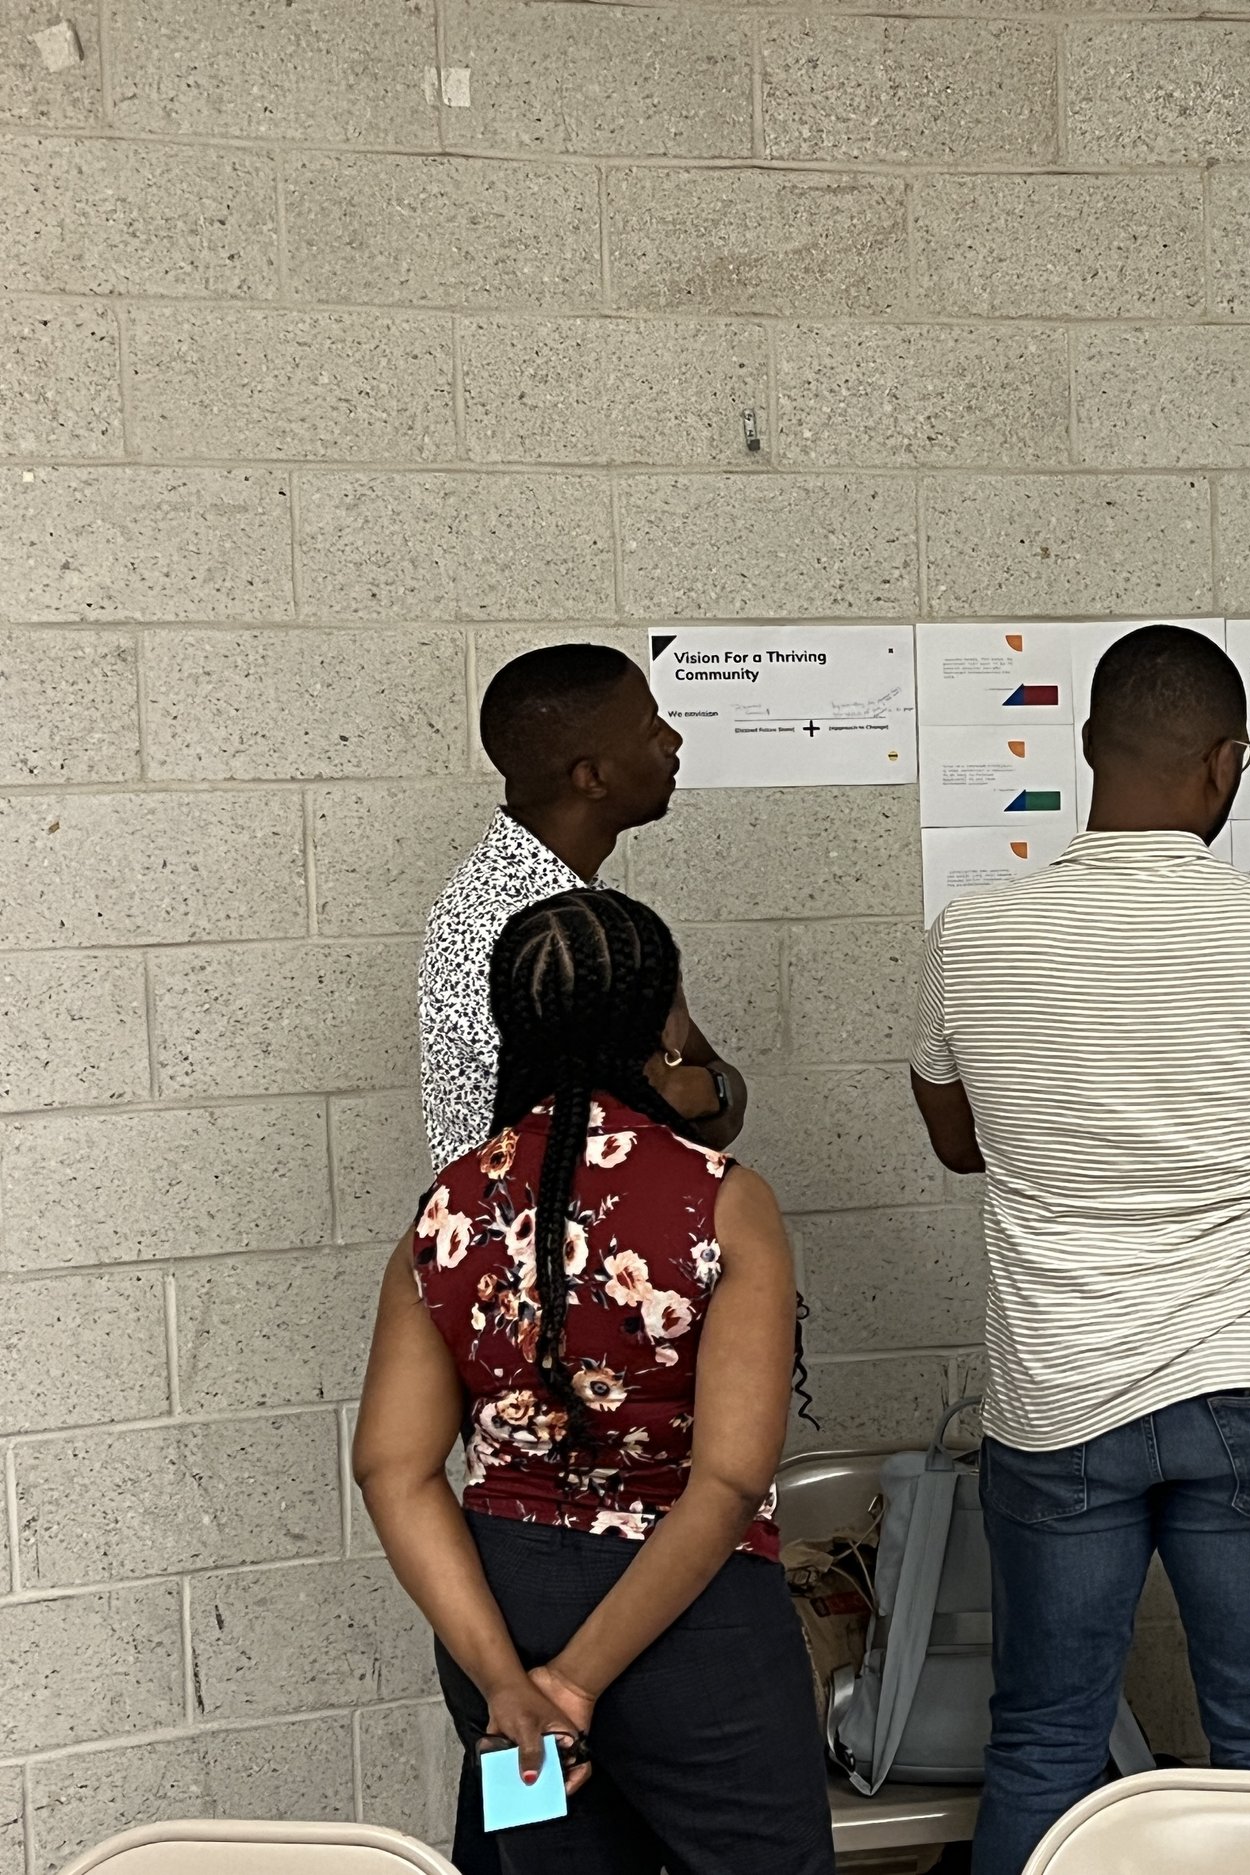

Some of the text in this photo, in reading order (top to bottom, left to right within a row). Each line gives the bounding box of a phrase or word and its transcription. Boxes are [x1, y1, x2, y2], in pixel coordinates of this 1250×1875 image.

[673, 650, 827, 665] Vision For a Thriving
[674, 667, 760, 683] Community
[667, 710, 682, 718] We
